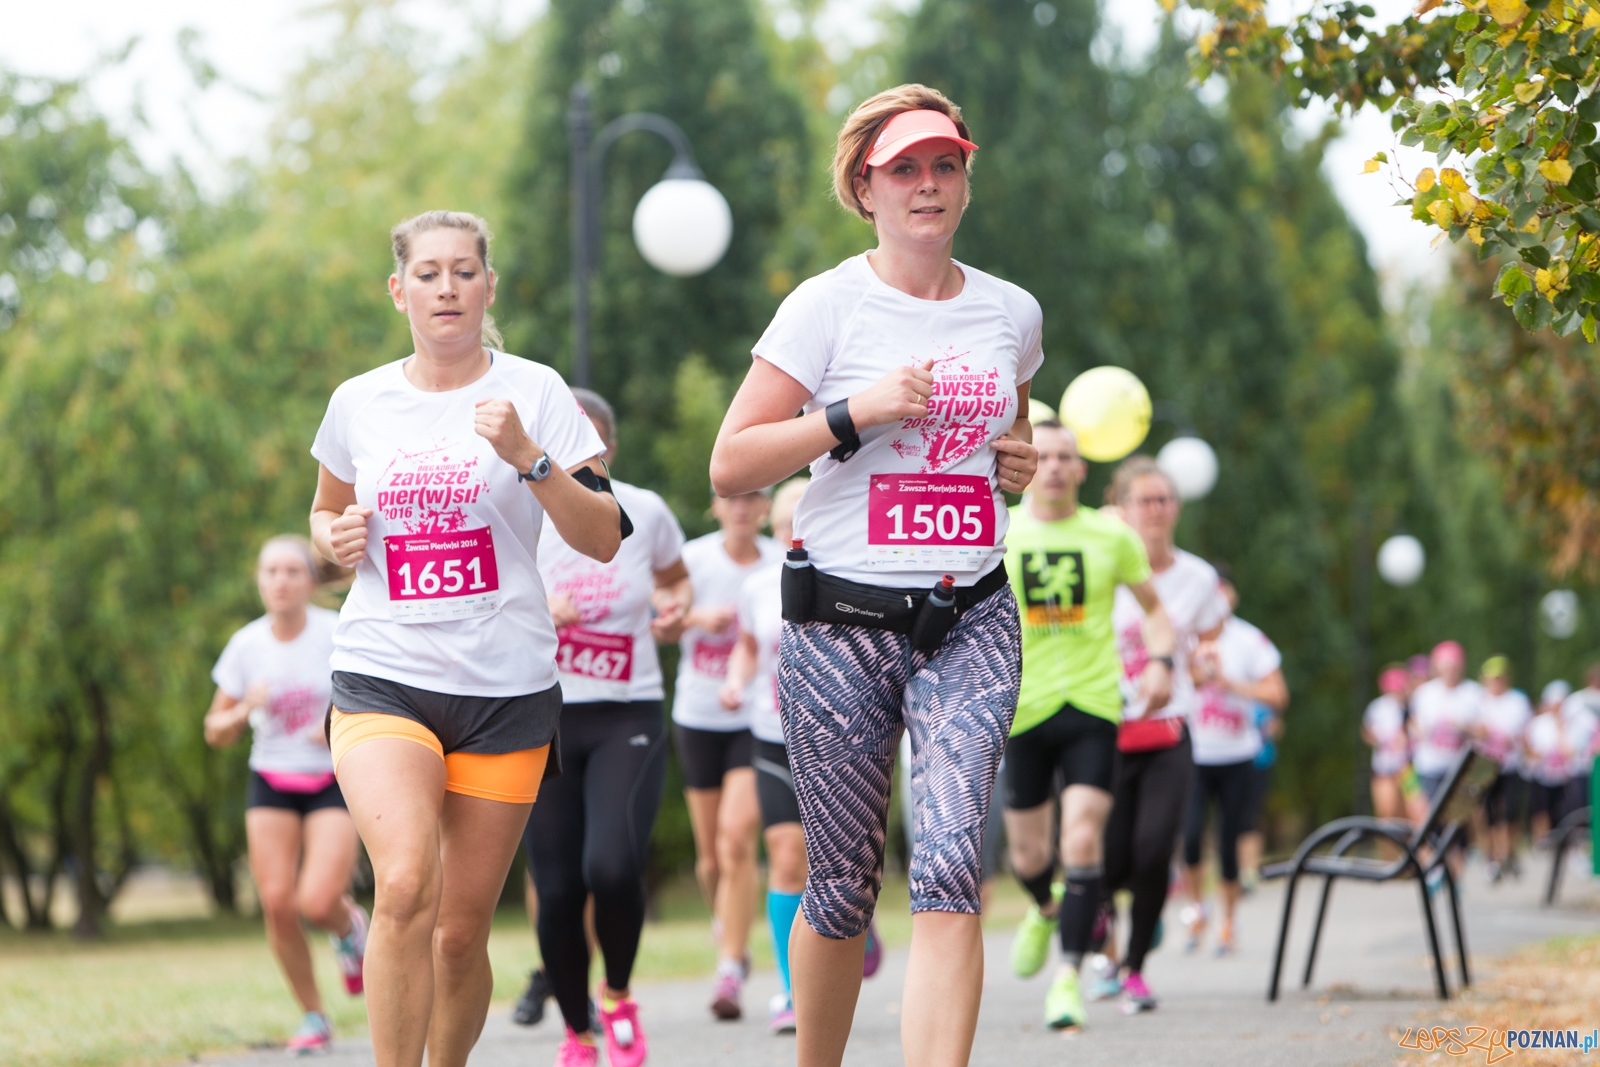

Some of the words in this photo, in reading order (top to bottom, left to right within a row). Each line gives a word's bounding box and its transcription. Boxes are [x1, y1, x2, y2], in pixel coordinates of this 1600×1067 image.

[932, 381, 996, 396] awsze
[927, 397, 1007, 422] er(w)si!
[901, 417, 937, 430] 2016
[936, 426, 977, 460] 15
[417, 464, 434, 472] BIEG
[389, 470, 470, 486] zawsze
[898, 484, 926, 492] Zawsze
[928, 484, 956, 493] Pier(w)si
[957, 485, 975, 493] 2016
[377, 484, 481, 511] pier(w)si!
[384, 506, 413, 520] 2016
[885, 504, 983, 540] 1505
[405, 543, 429, 552] Zawsze
[460, 539, 478, 548] 2016
[398, 556, 486, 596] 1651
[854, 607, 884, 619] Kalenji
[560, 643, 628, 679] 1467
